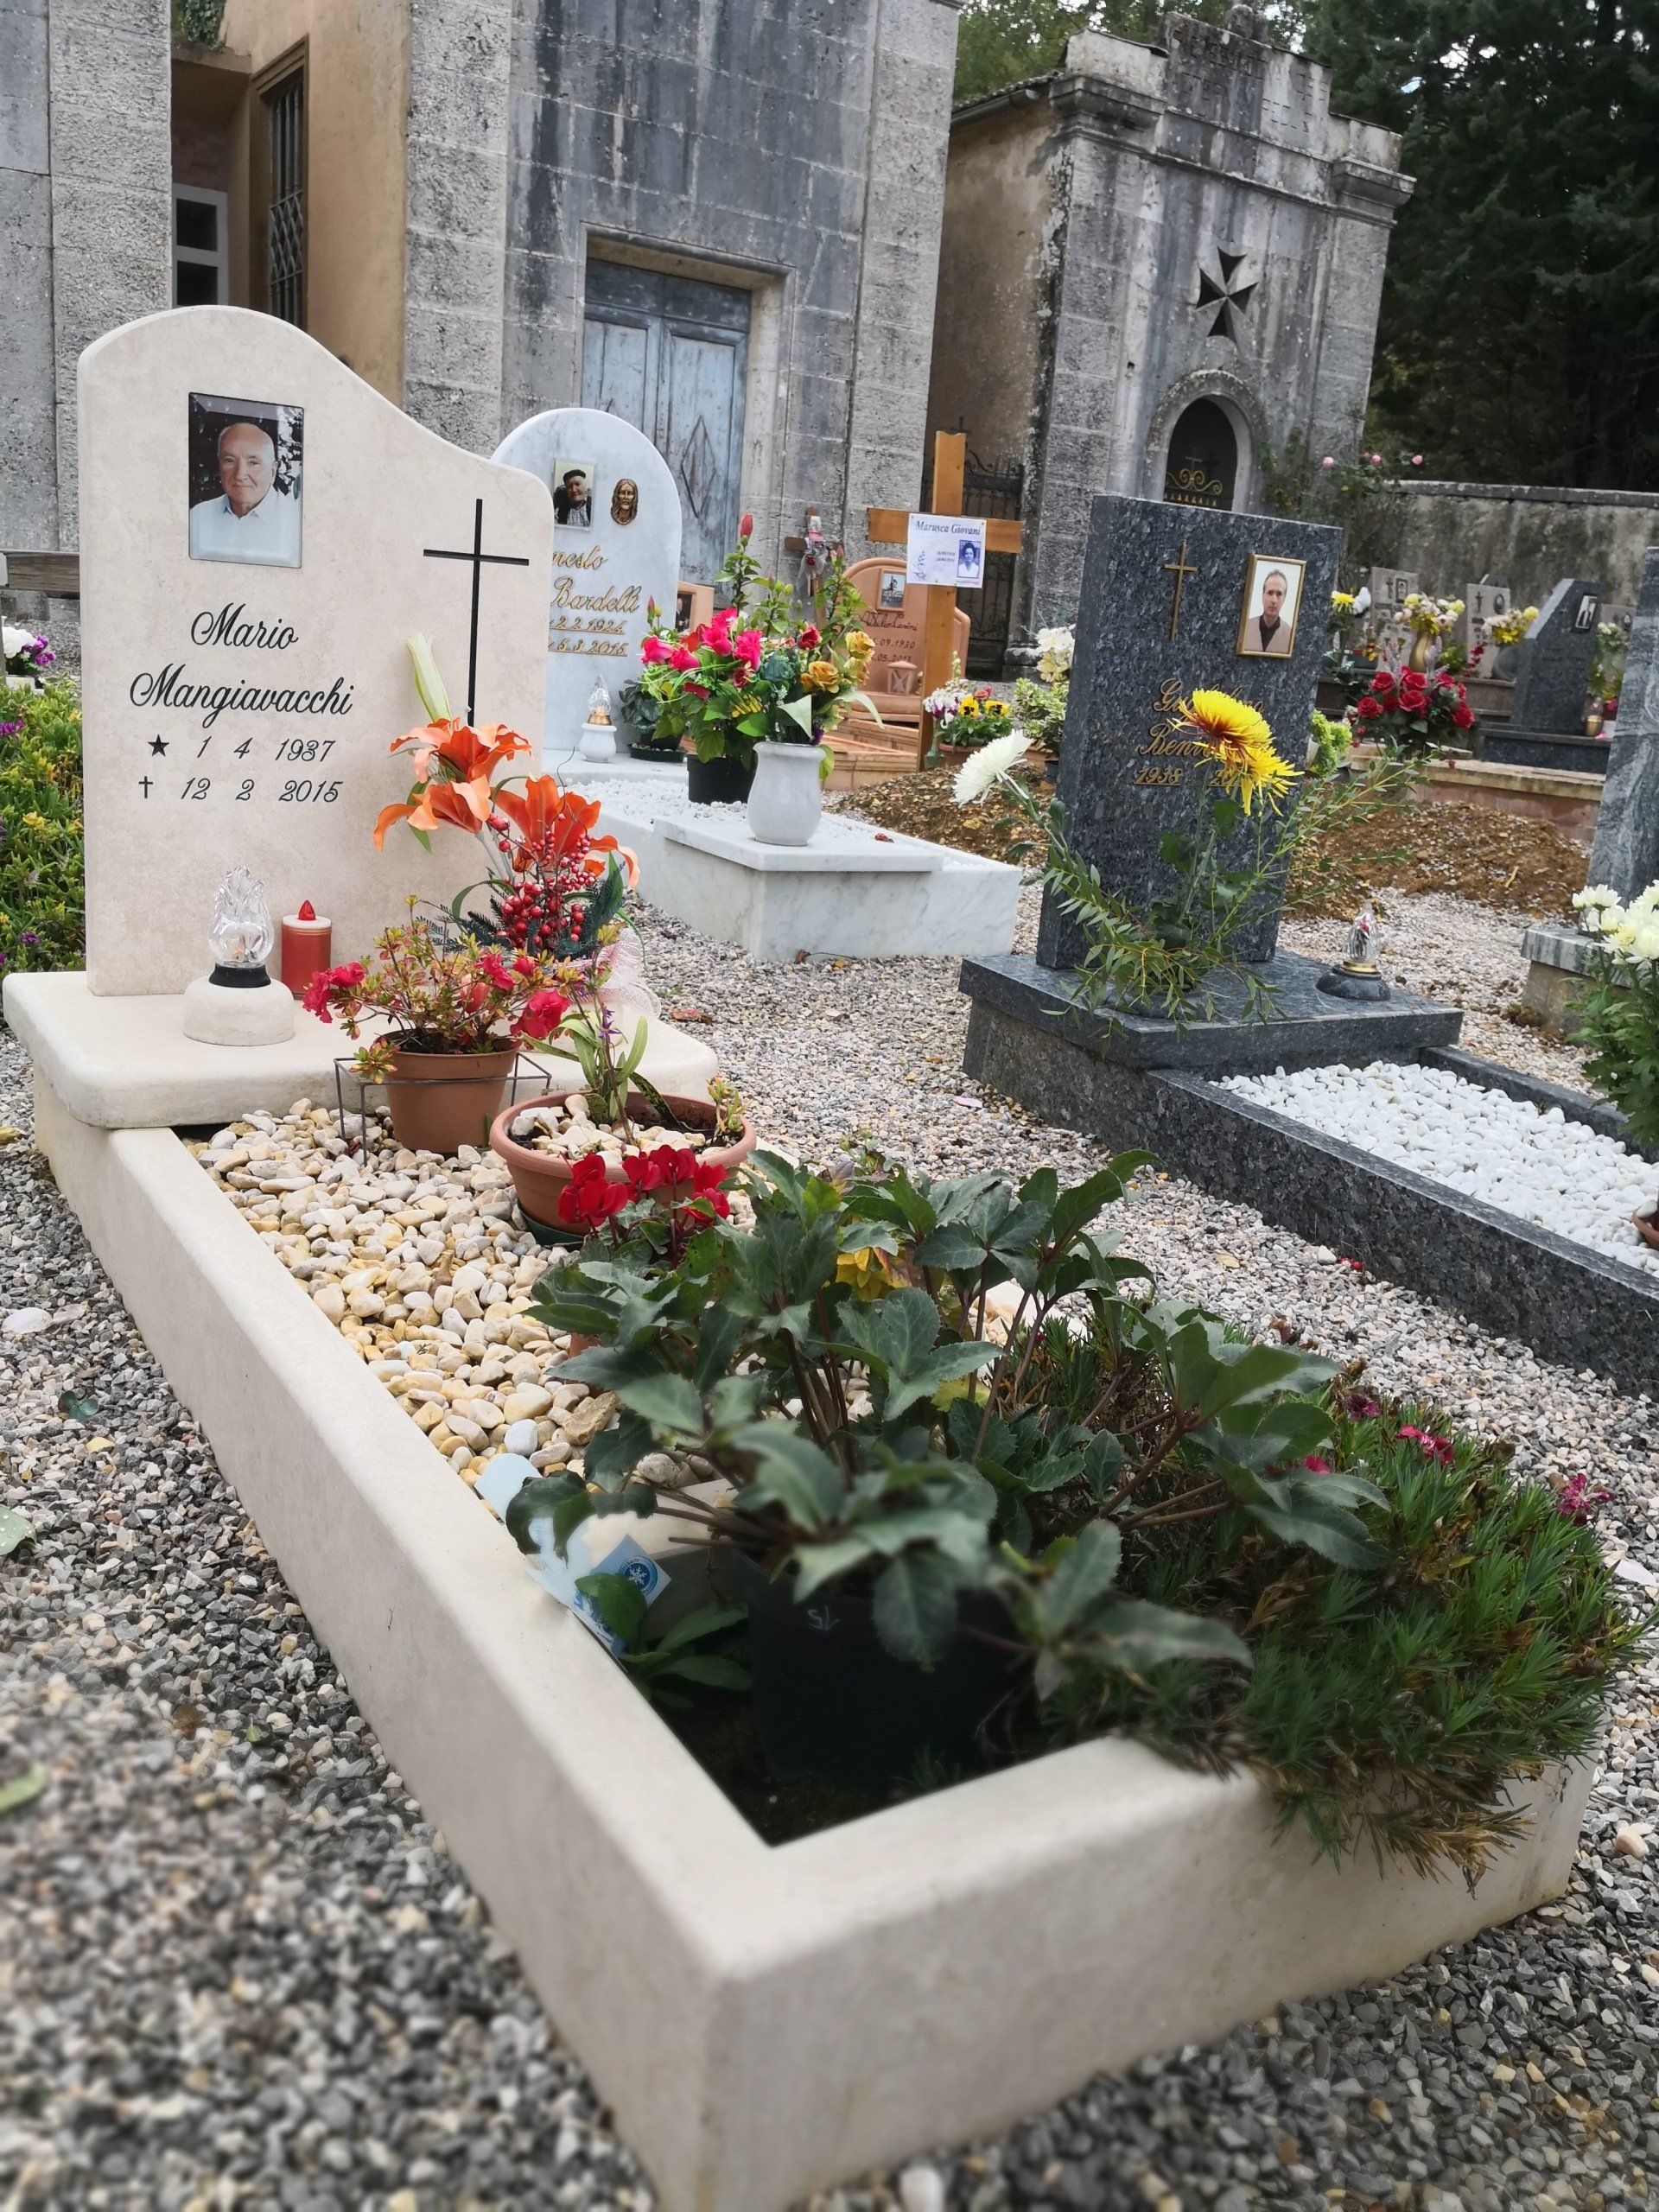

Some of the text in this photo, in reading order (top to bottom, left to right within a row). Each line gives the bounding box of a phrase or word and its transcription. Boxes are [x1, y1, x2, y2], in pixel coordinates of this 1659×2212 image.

[916, 520, 981, 536] Marusca Giovani
[551, 576, 642, 613] Bardelli
[190, 602, 299, 649] Mario
[130, 663, 354, 728] Mangiavacchi
[196, 735, 336, 762] 1 4 1937
[1134, 767, 1183, 785] 1938
[180, 777, 344, 803] 12 2 2015
